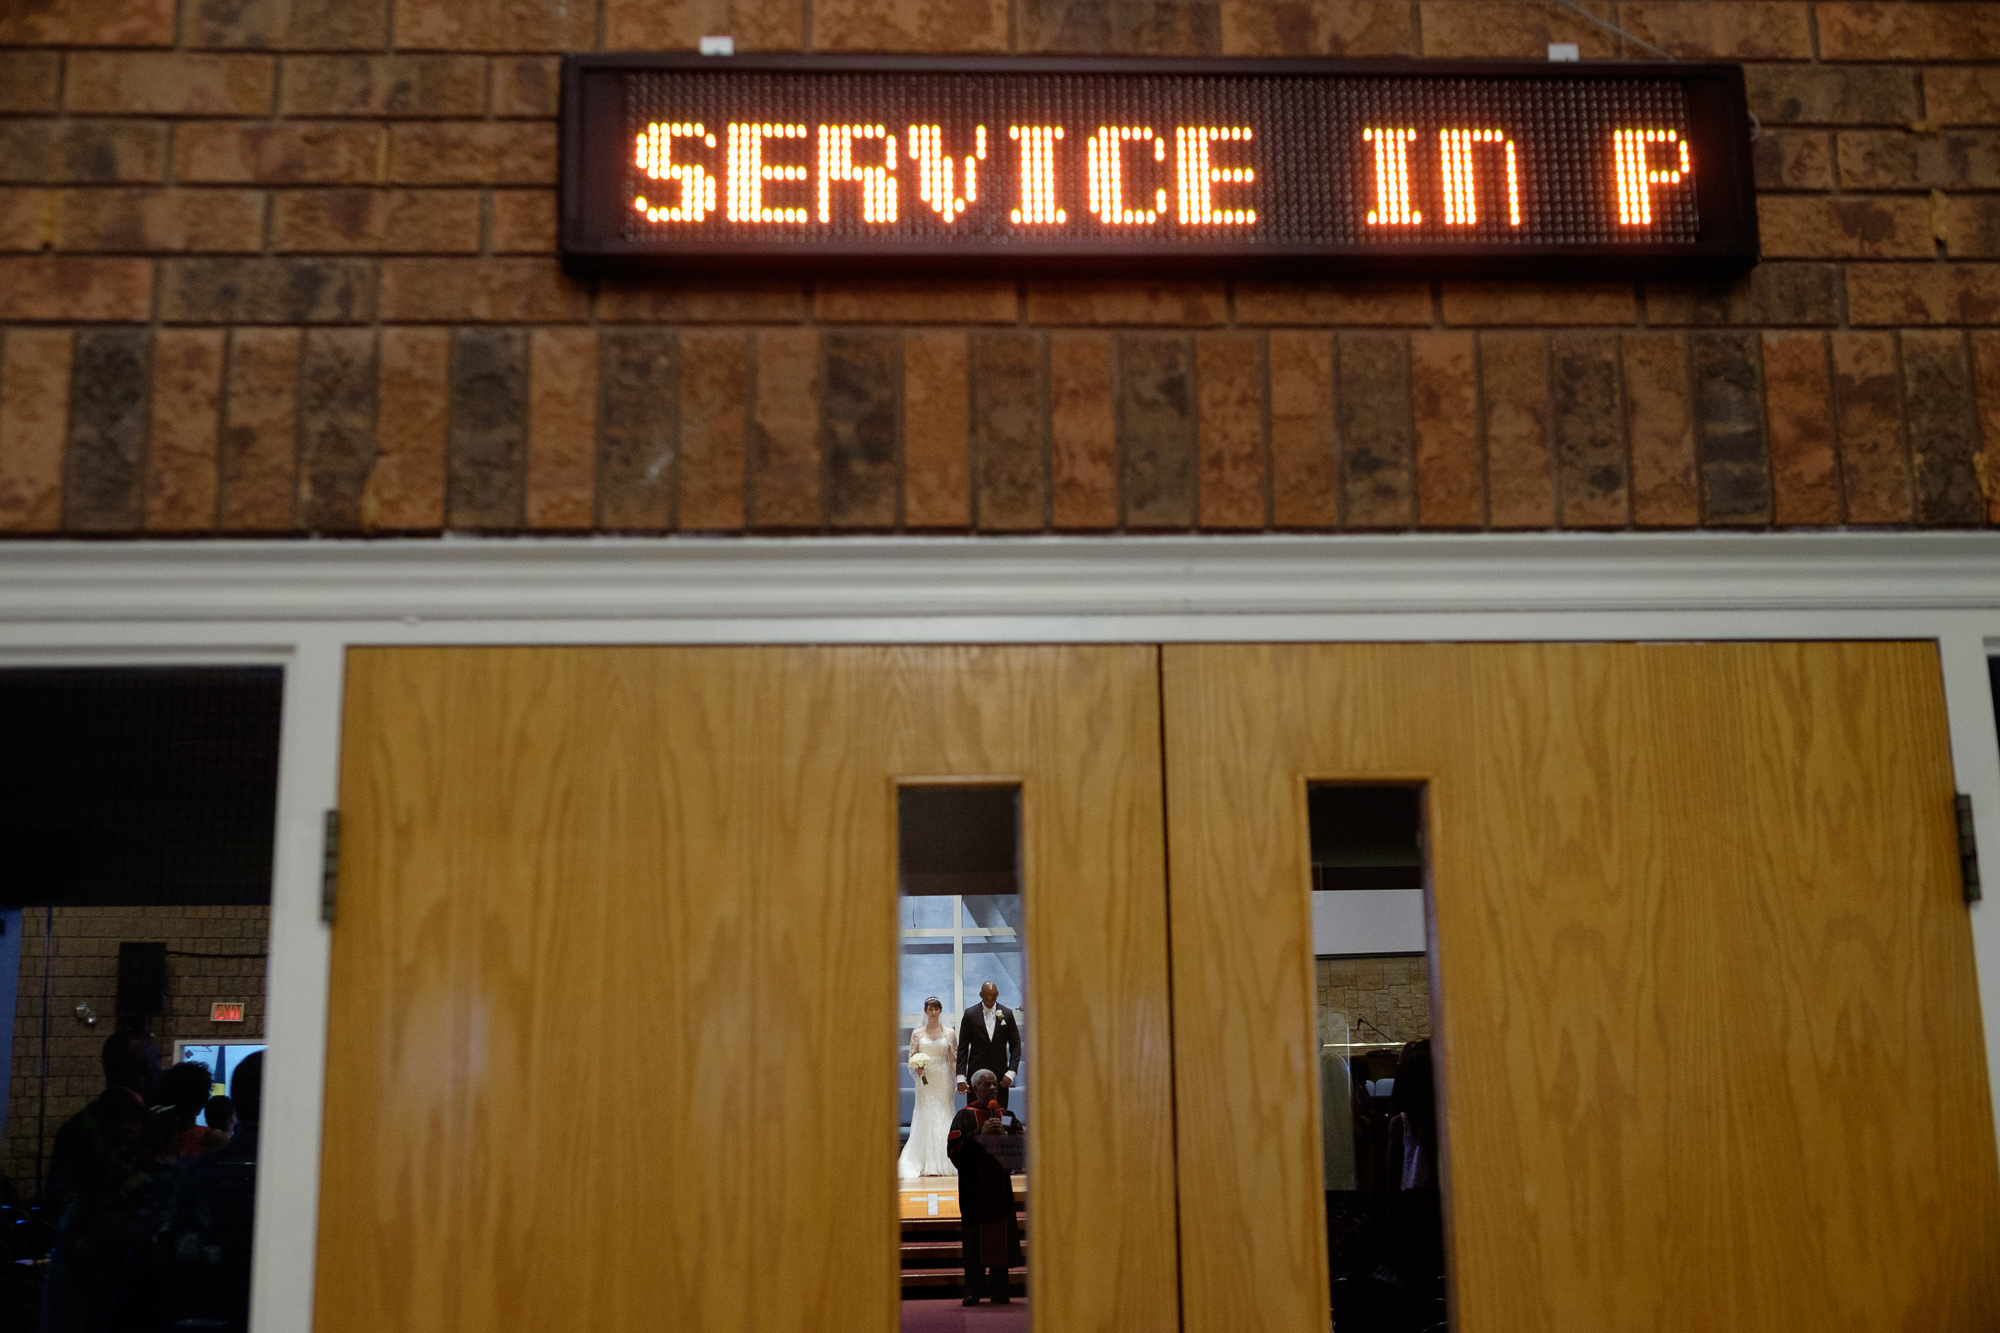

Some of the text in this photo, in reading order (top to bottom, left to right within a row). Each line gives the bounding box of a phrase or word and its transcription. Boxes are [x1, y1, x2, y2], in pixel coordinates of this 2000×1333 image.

[634, 121, 1691, 228] SERVICE IN P
[215, 1004, 242, 1020] EXIT
